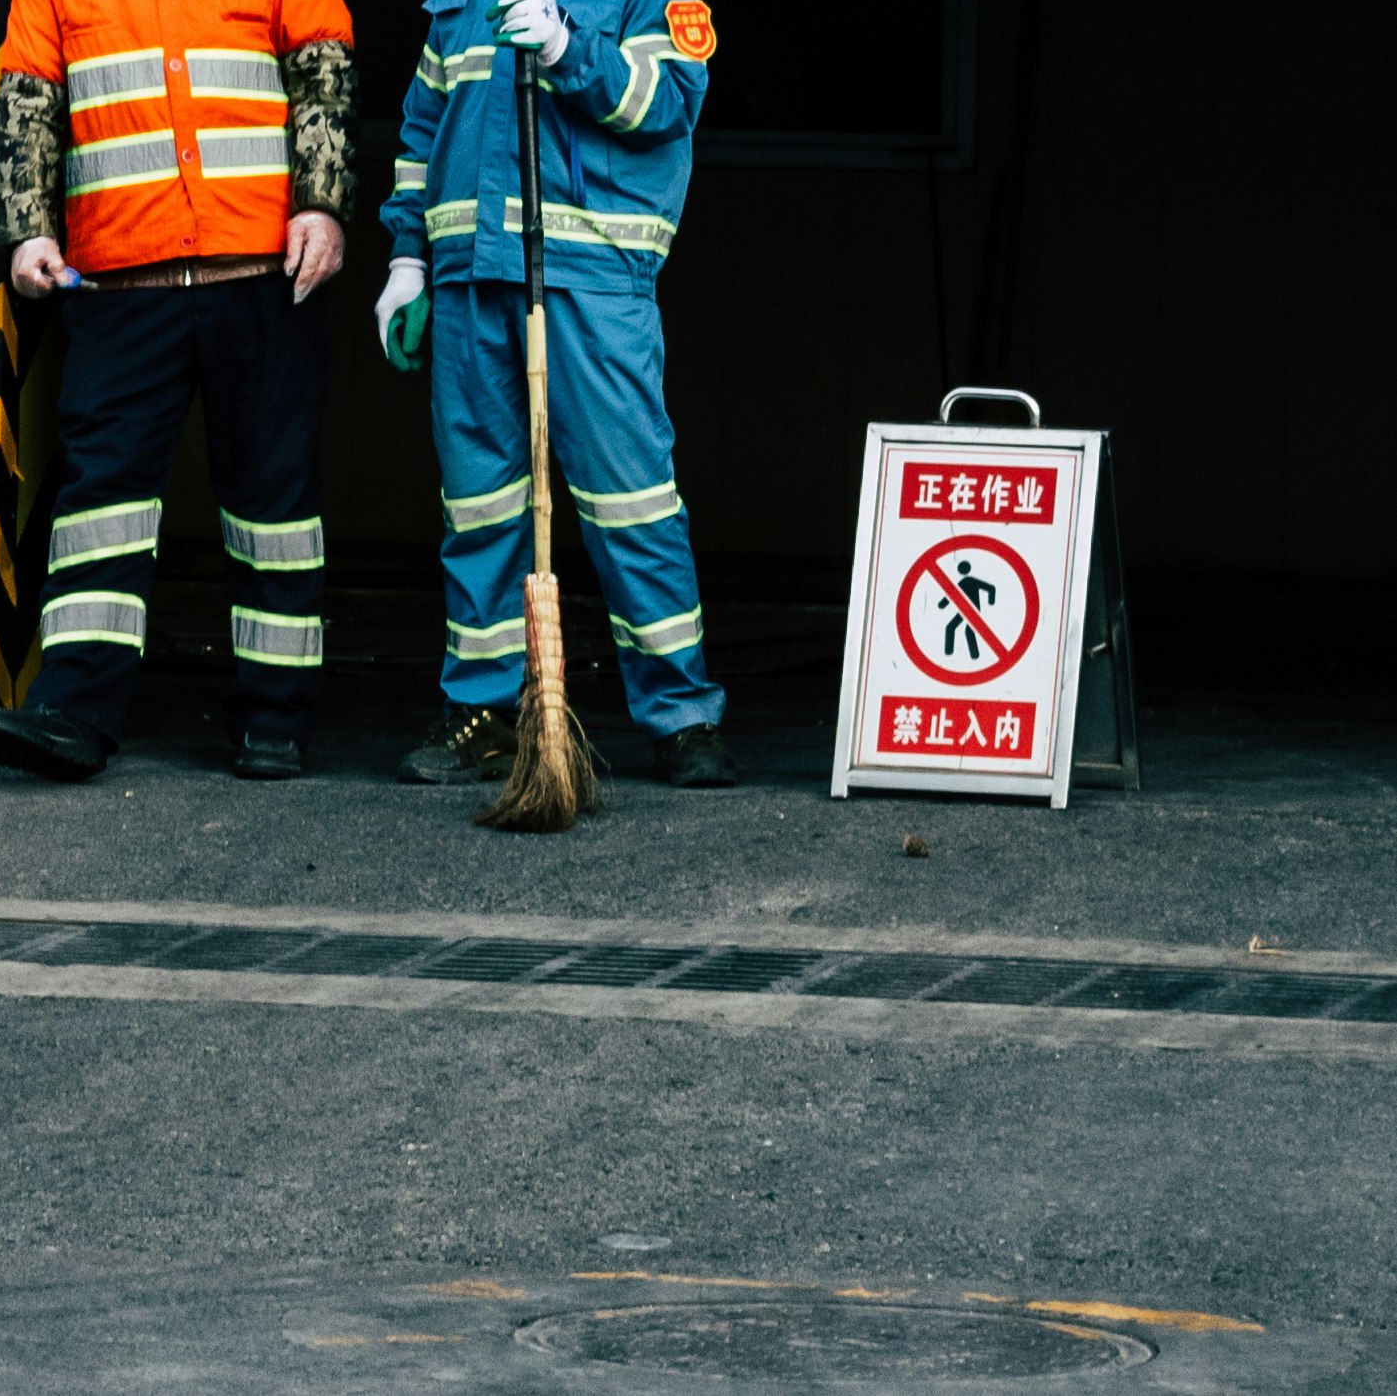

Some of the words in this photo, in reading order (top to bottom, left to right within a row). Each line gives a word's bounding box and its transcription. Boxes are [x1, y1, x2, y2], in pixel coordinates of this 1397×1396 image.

[913, 473, 1045, 515] 正在作业
[892, 705, 1021, 750] 禁止入内
